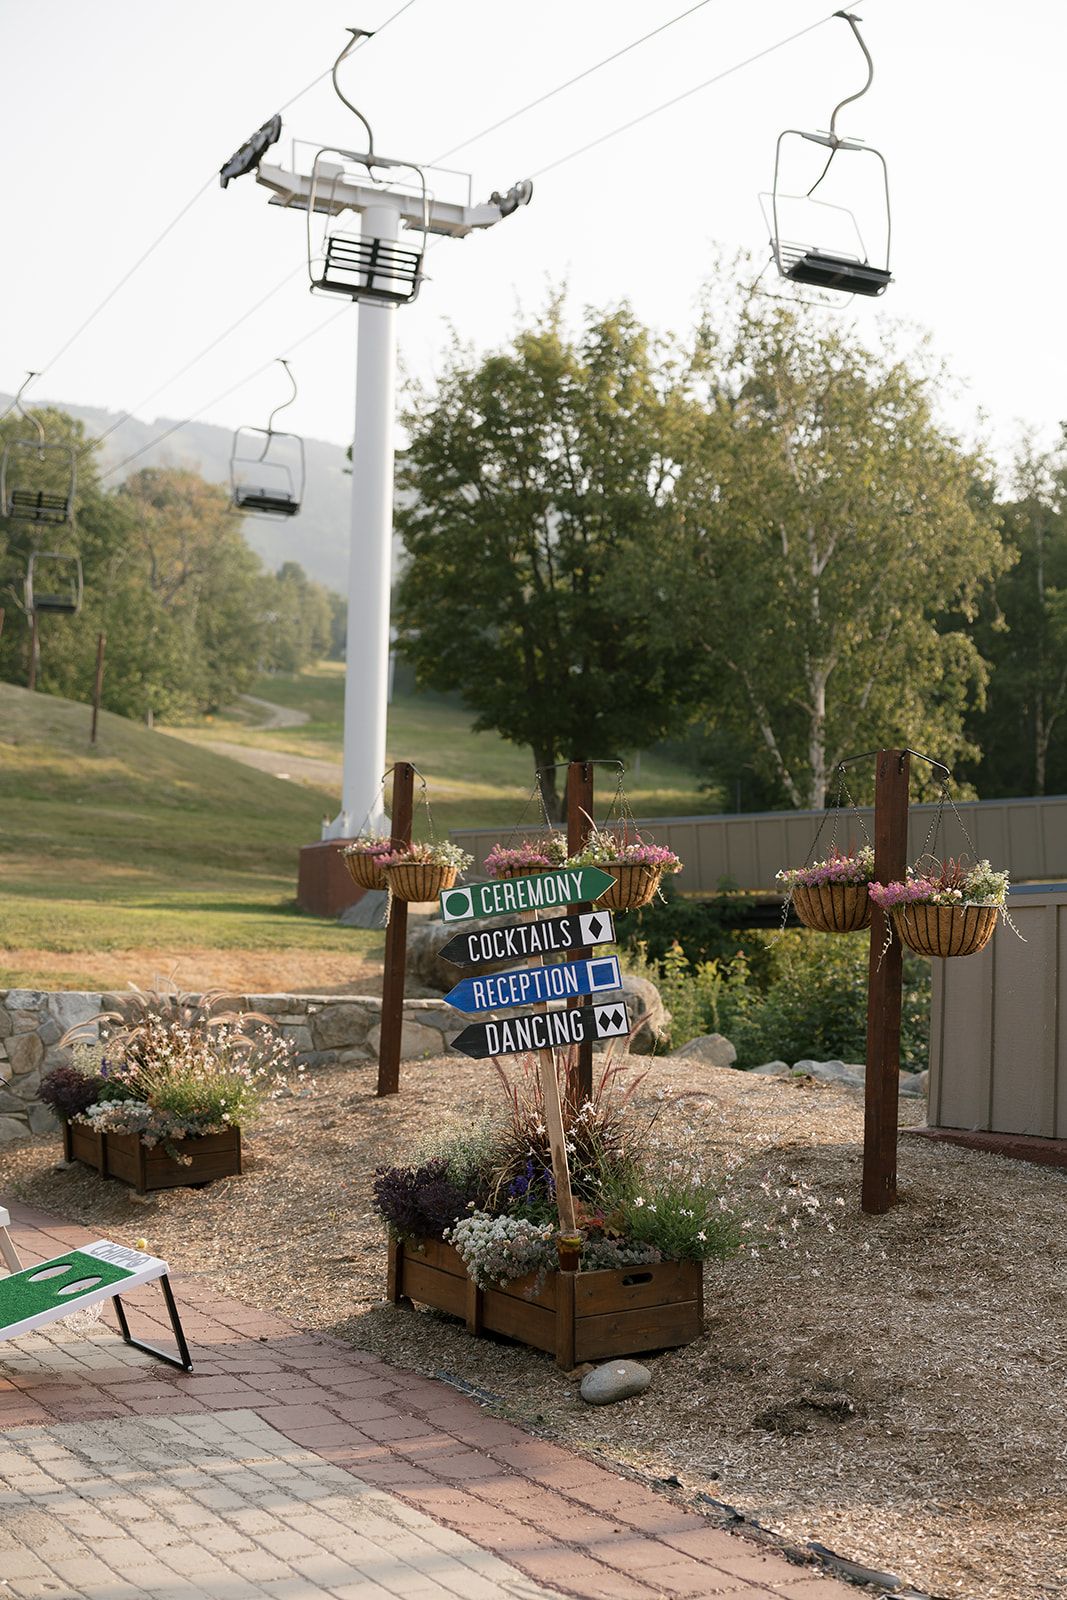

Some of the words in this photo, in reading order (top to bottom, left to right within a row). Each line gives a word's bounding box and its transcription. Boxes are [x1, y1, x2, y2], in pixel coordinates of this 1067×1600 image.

[480, 871, 583, 914] CEREMONY
[467, 919, 572, 963] COCKTAILS
[472, 965, 579, 1009] RECEPTION
[485, 1010, 585, 1056] DANCING
